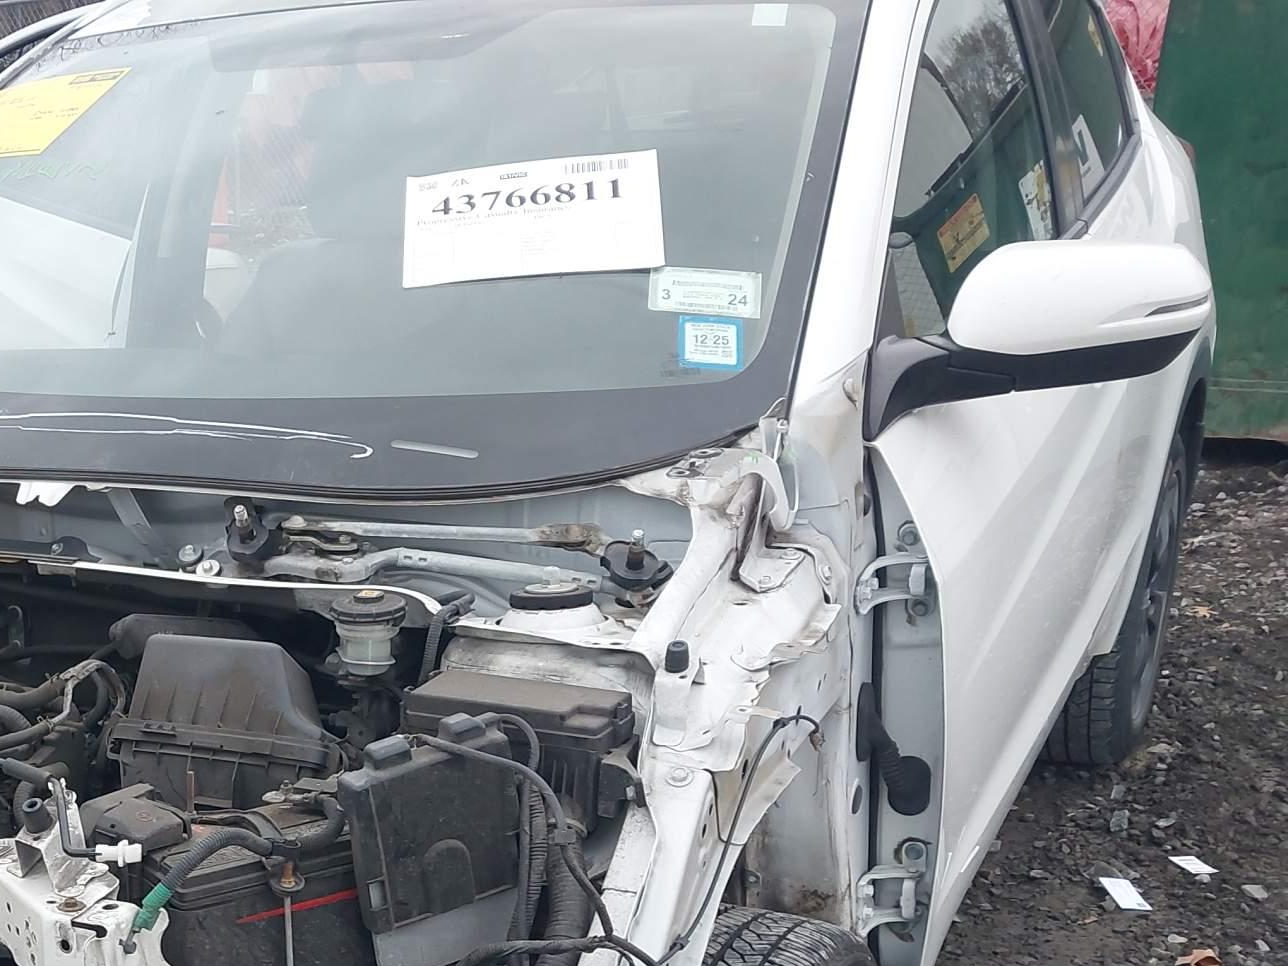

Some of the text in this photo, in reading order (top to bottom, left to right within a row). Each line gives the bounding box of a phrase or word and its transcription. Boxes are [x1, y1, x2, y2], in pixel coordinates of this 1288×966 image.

[432, 178, 624, 215] 43766811
[661, 288, 671, 300] 3
[727, 293, 748, 307] 24
